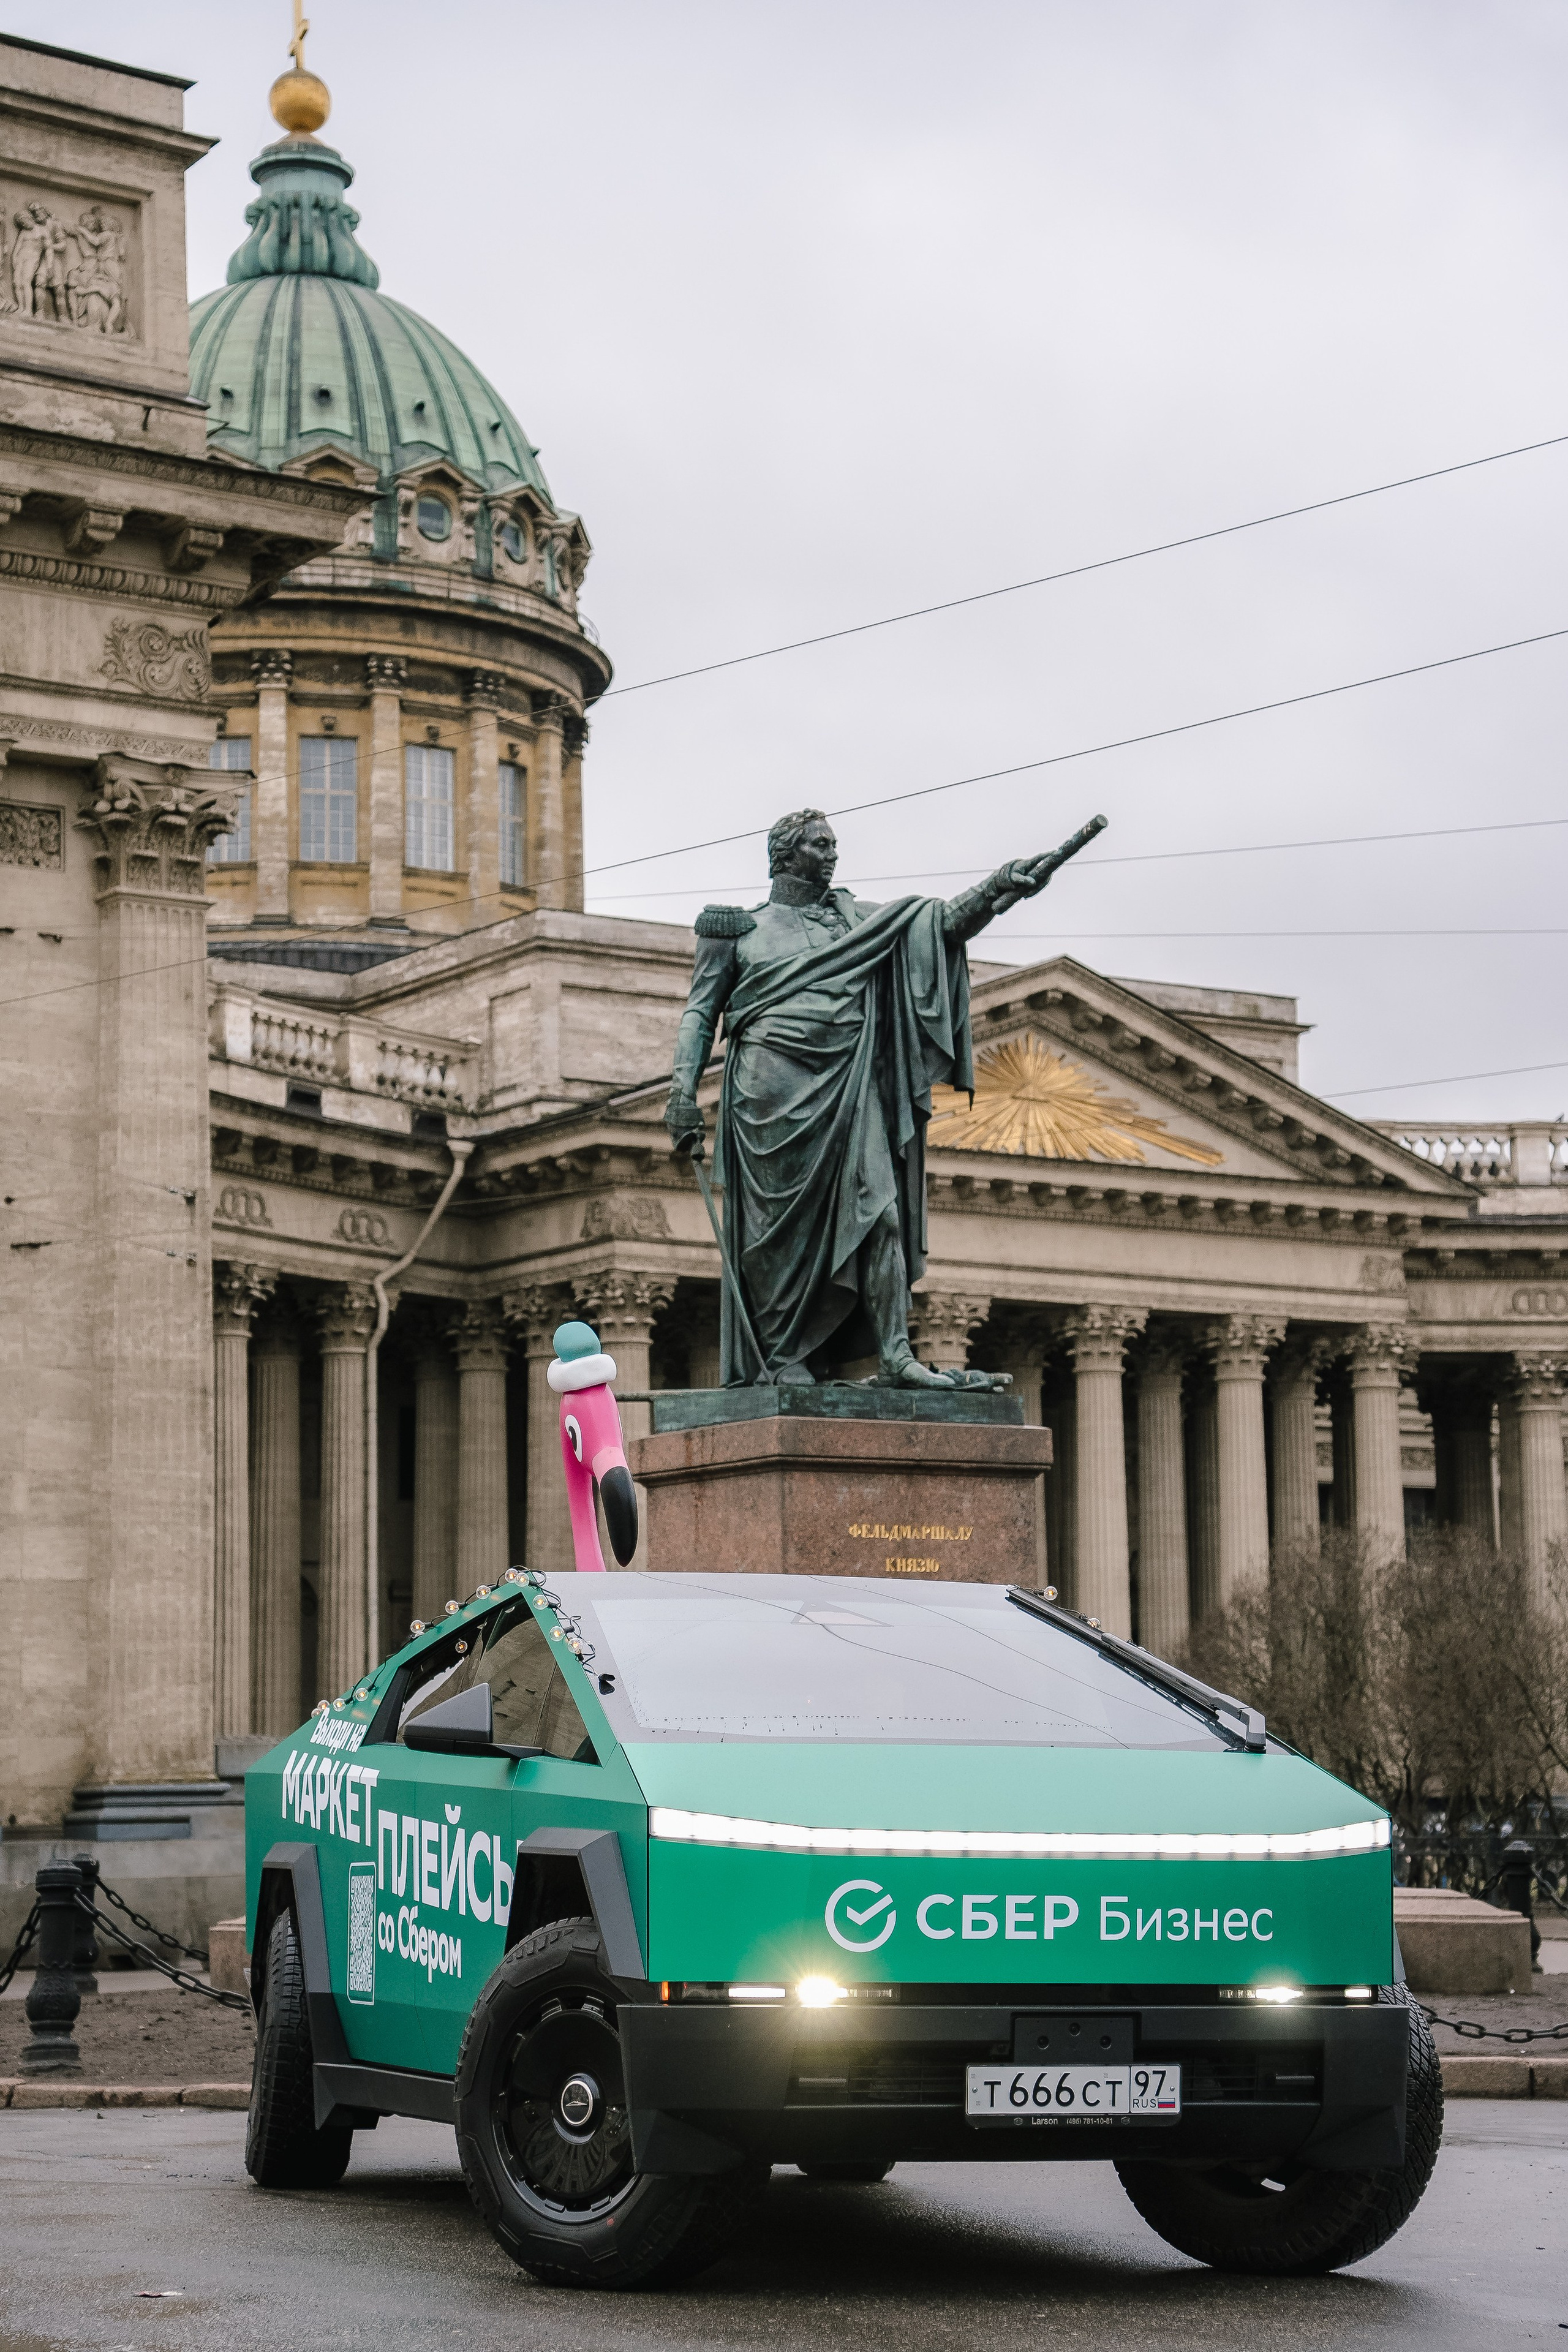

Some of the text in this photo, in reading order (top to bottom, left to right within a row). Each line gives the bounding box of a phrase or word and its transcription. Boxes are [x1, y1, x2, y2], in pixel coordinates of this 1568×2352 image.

[848, 1523, 974, 1541] ФЕЛЬДМАРШАЛУ
[885, 1558, 940, 1573] КНЯЗЮ
[309, 1707, 368, 1755] Выходи на
[282, 1750, 380, 1847] МАРКЕТ
[916, 1894, 1274, 1942] СБЕР Бизнес
[378, 1905, 462, 1983] со Сбером
[1134, 2070, 1167, 2097] 97
[1133, 2098, 1156, 2109] RUS
[1031, 2117, 1058, 2125] Larson
